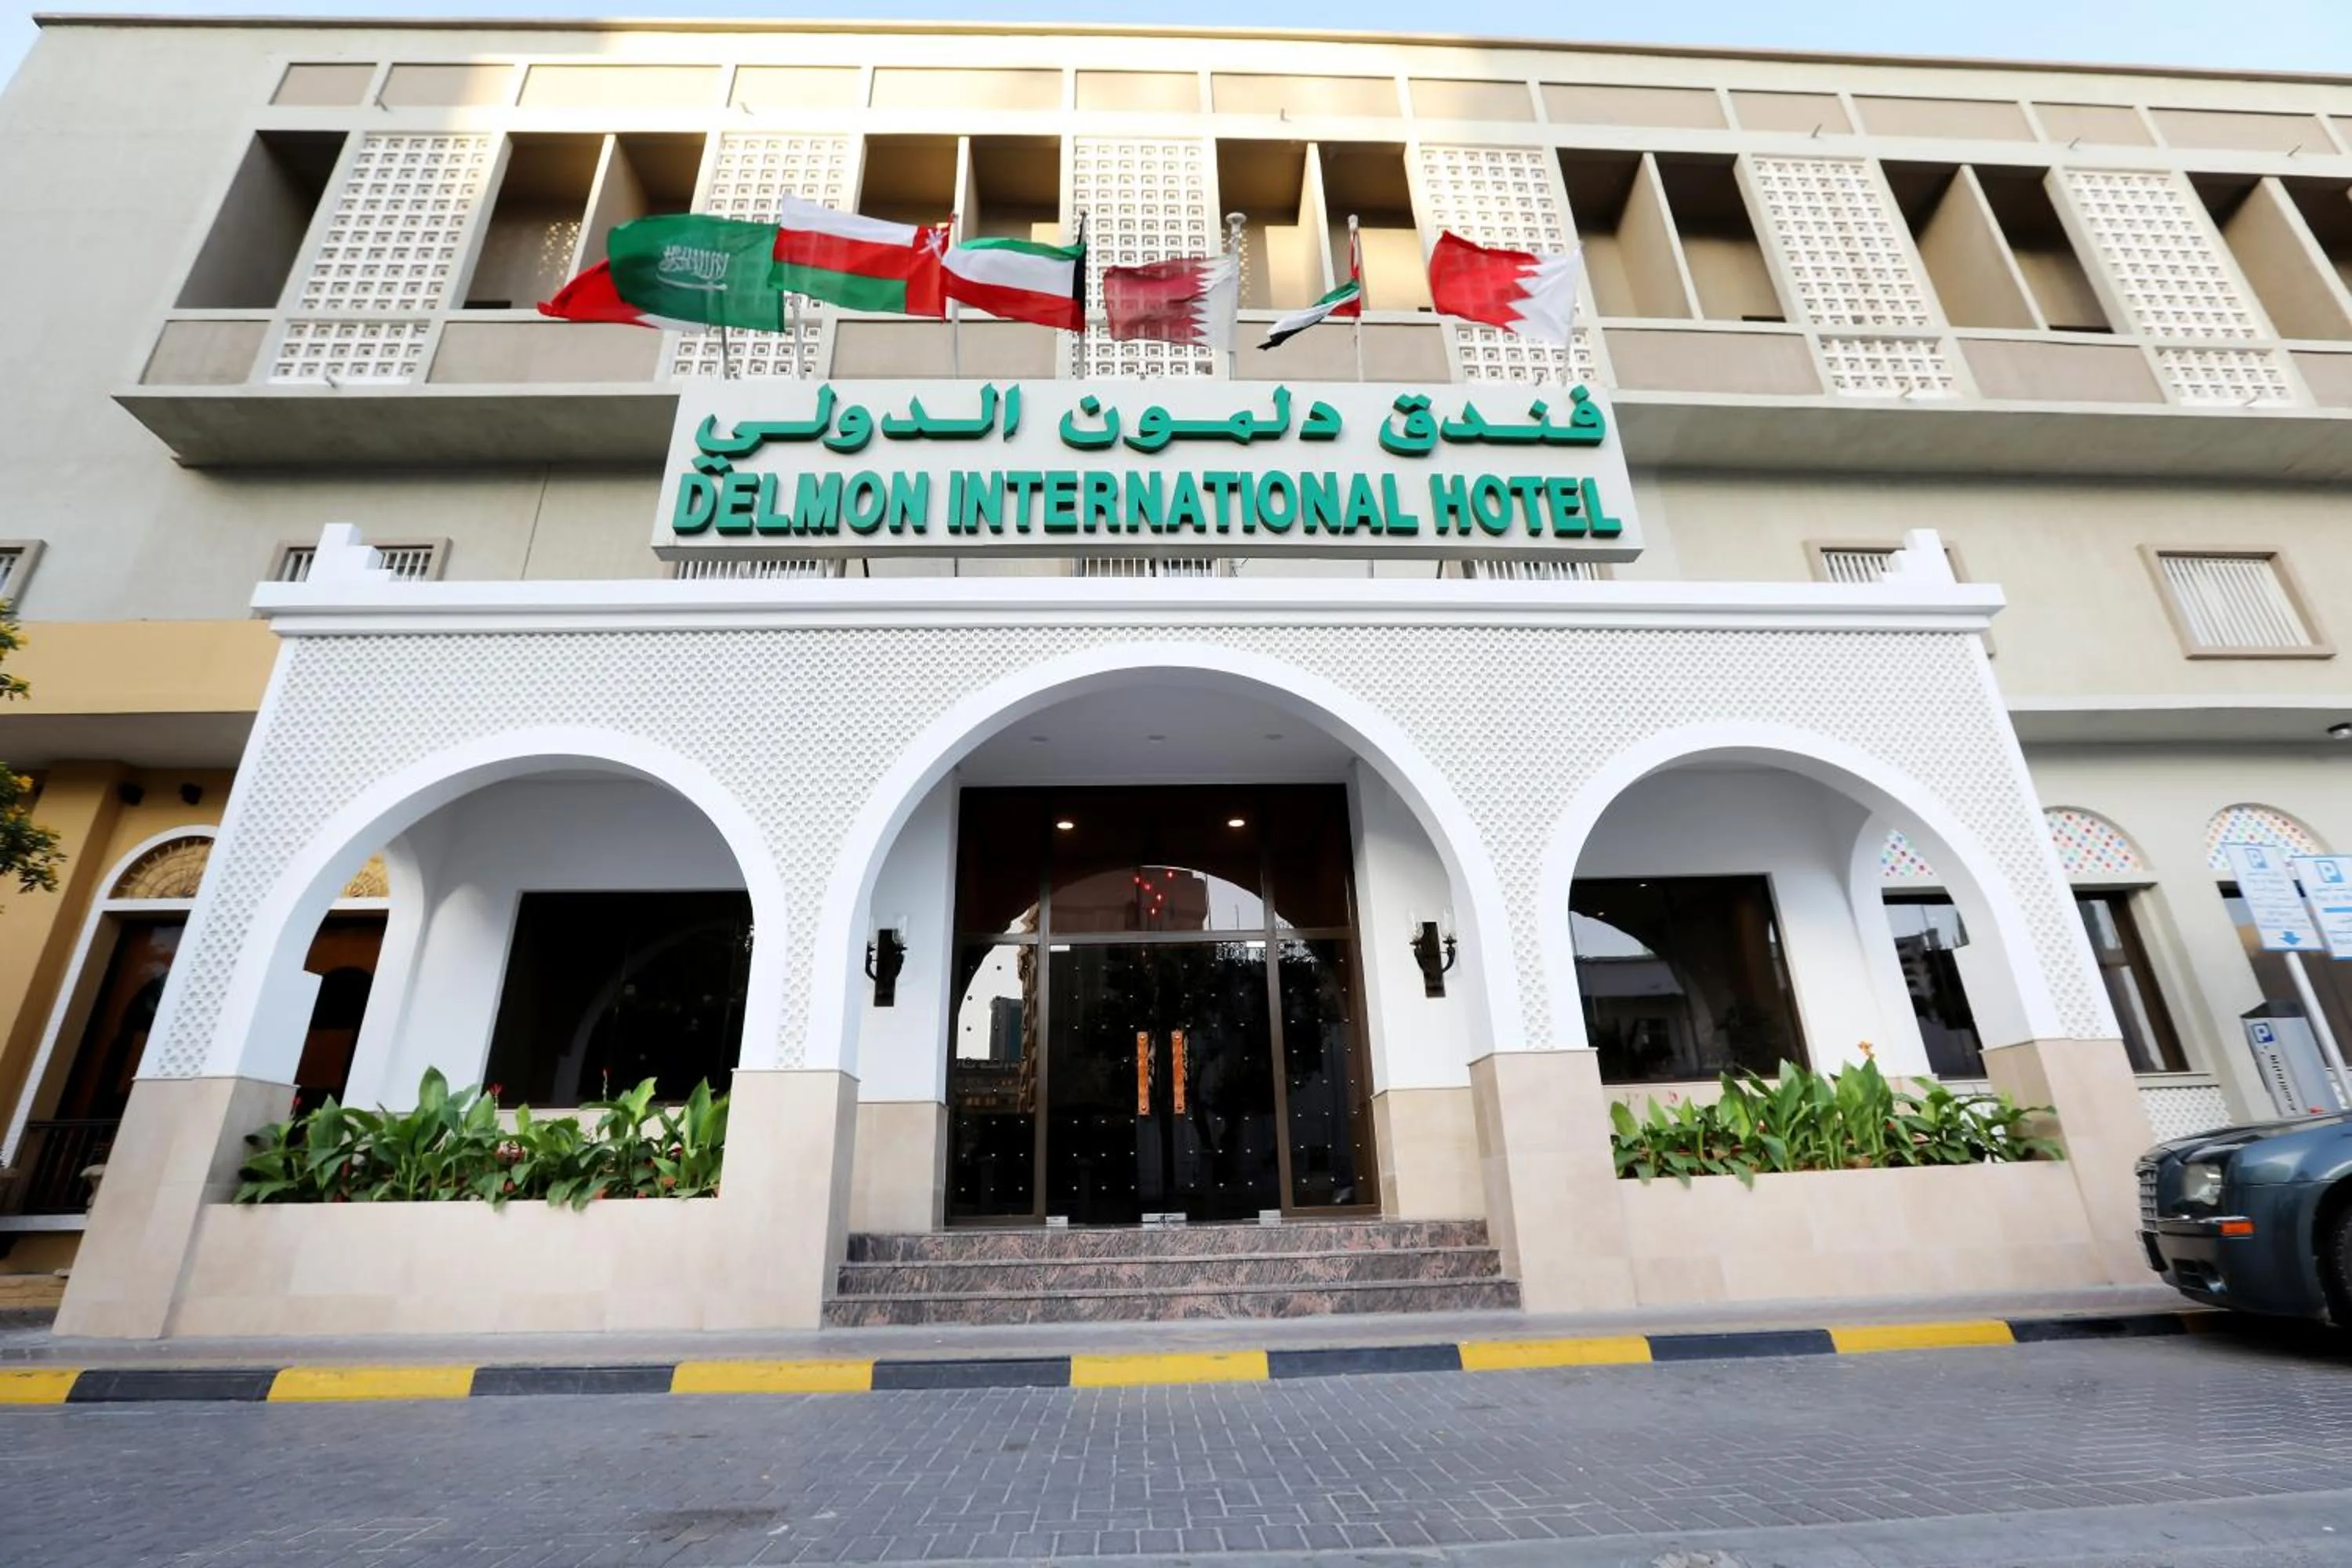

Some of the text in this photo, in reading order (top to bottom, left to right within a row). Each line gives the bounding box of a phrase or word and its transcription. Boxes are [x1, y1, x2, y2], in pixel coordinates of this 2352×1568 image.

[691, 382, 1606, 476] فندق دلمون الدولي
[673, 470, 1622, 538] DELMON INTERNATIONAL HOTEL
